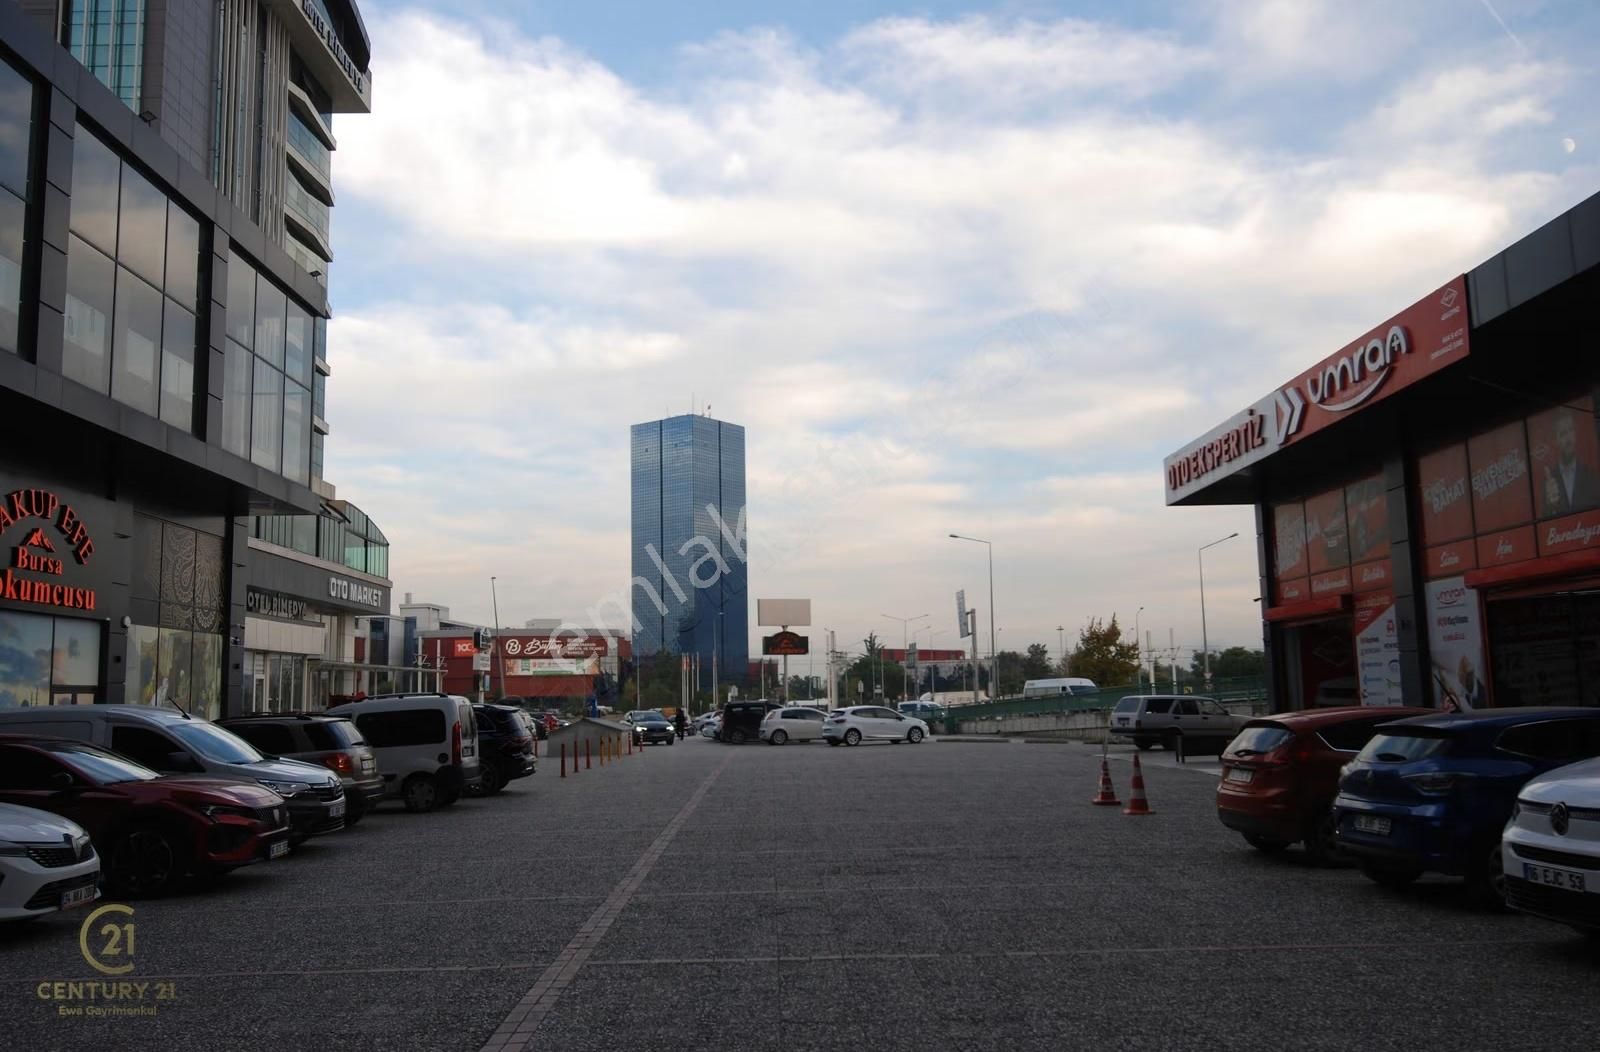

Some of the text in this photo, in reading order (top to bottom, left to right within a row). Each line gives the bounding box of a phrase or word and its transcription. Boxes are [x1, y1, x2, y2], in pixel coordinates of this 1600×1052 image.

[16, 545, 64, 576] Bursa
[329, 577, 383, 608] OTO MARKET
